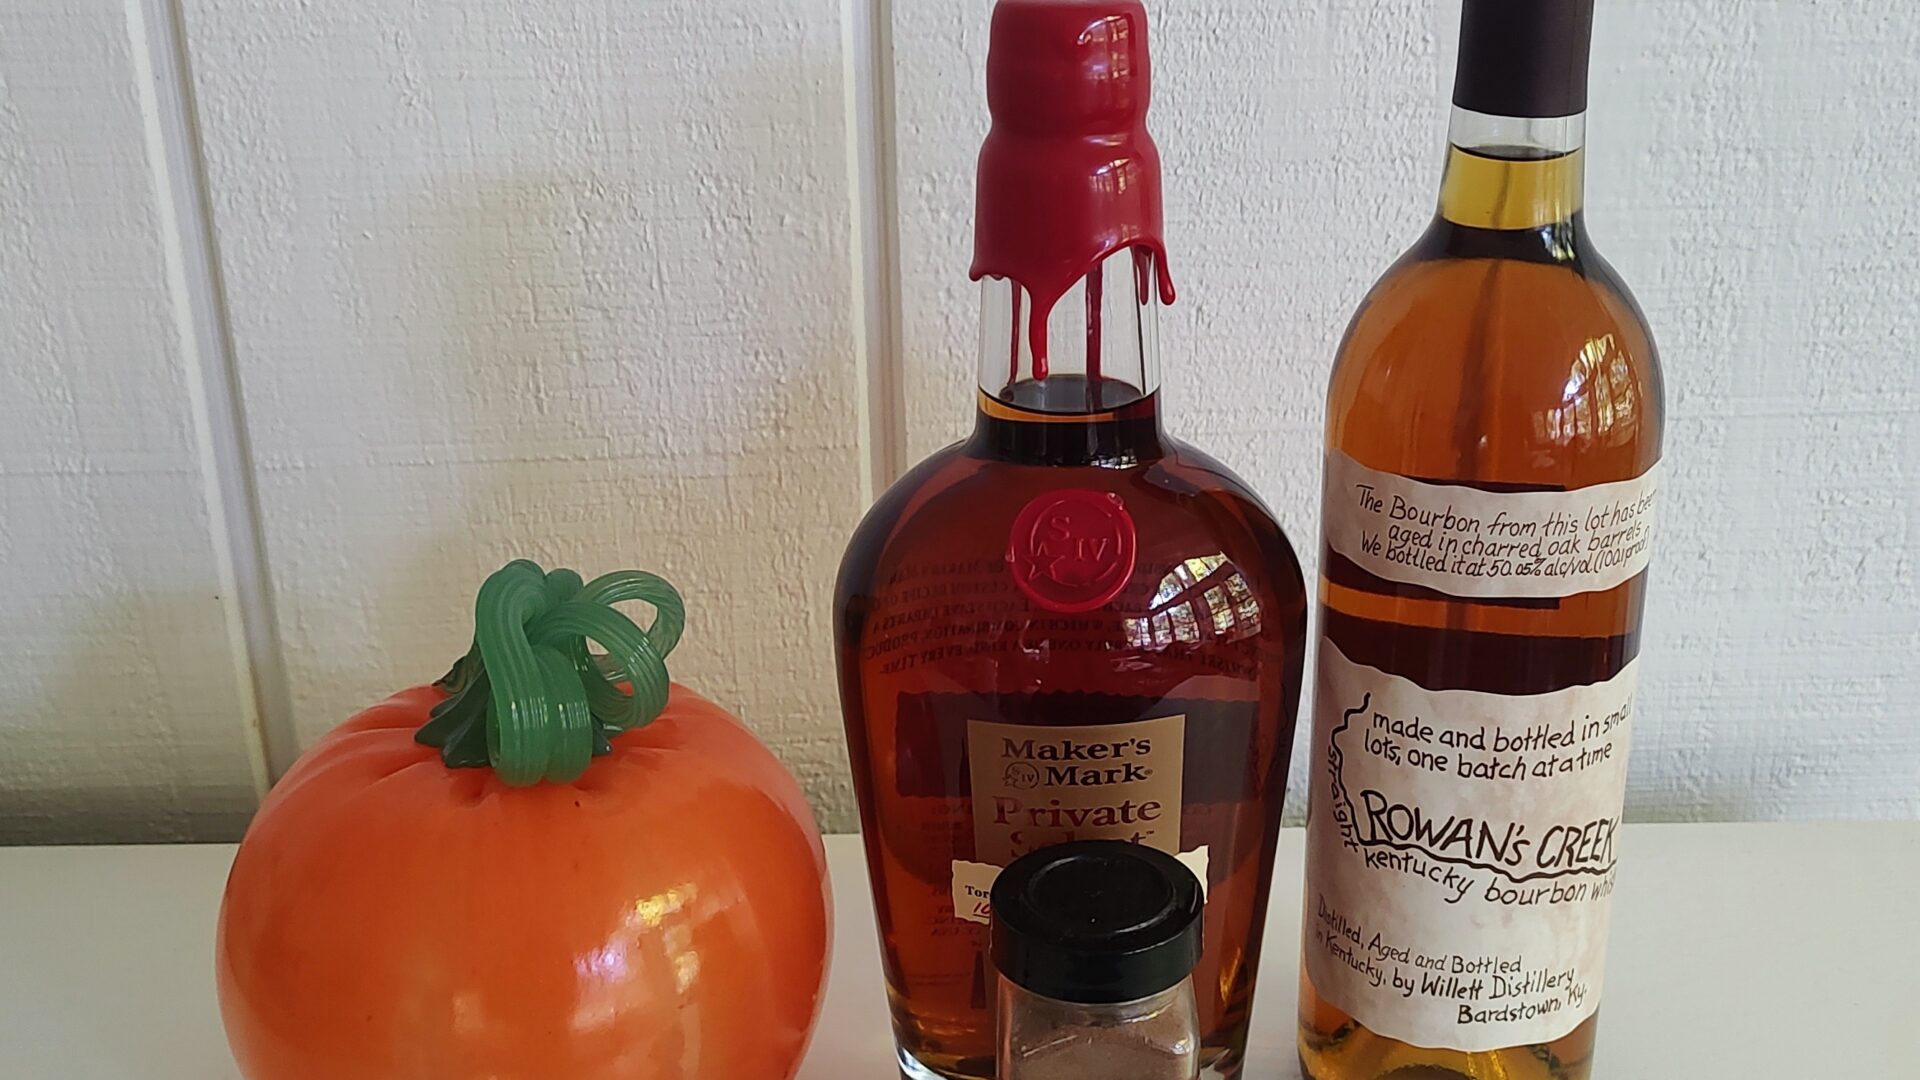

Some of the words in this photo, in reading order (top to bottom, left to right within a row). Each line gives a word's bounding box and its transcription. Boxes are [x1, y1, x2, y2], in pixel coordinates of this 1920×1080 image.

[1356, 484, 1383, 513] The
[1389, 495, 1480, 533] Bourbon
[1488, 511, 1537, 538] from
[1542, 512, 1578, 537] this
[1585, 505, 1609, 531] lot
[1610, 500, 1635, 527] has
[1361, 530, 1382, 557] We
[1386, 541, 1447, 572] bottled
[1389, 525, 1432, 550] aged
[1439, 534, 1457, 553] in
[1462, 537, 1542, 559] charred
[1548, 538, 1580, 556] oak
[1588, 519, 1642, 551] barrels
[1373, 712, 1432, 743] made
[1440, 727, 1485, 751] and
[1494, 720, 1575, 752] bottled
[1581, 714, 1600, 741] in
[1602, 692, 1632, 734] small
[1000, 737, 1151, 762] Maker's
[1365, 729, 1400, 766] lots,
[1408, 753, 1448, 771] one
[1458, 753, 1526, 780] batch
[1532, 756, 1557, 777] at
[1559, 757, 1573, 772] a
[1576, 743, 1612, 771] time
[992, 796, 1161, 828] Private
[1328, 745, 1359, 853] straight
[1537, 815, 1620, 868] CREEK
[964, 884, 990, 899] Tor
[1364, 848, 1474, 904] kentucky
[1485, 877, 1587, 905] bourbon
[1318, 892, 1364, 949] Distilled,
[1368, 932, 1409, 961] Aged
[1415, 954, 1446, 972] and
[1451, 955, 1522, 974] Bottled
[1326, 930, 1386, 987] Kentucky,
[1392, 974, 1415, 998] by
[1421, 972, 1484, 1000] Willett
[1489, 968, 1574, 1000] Distillery
[1457, 998, 1562, 1024] Bardstown,
